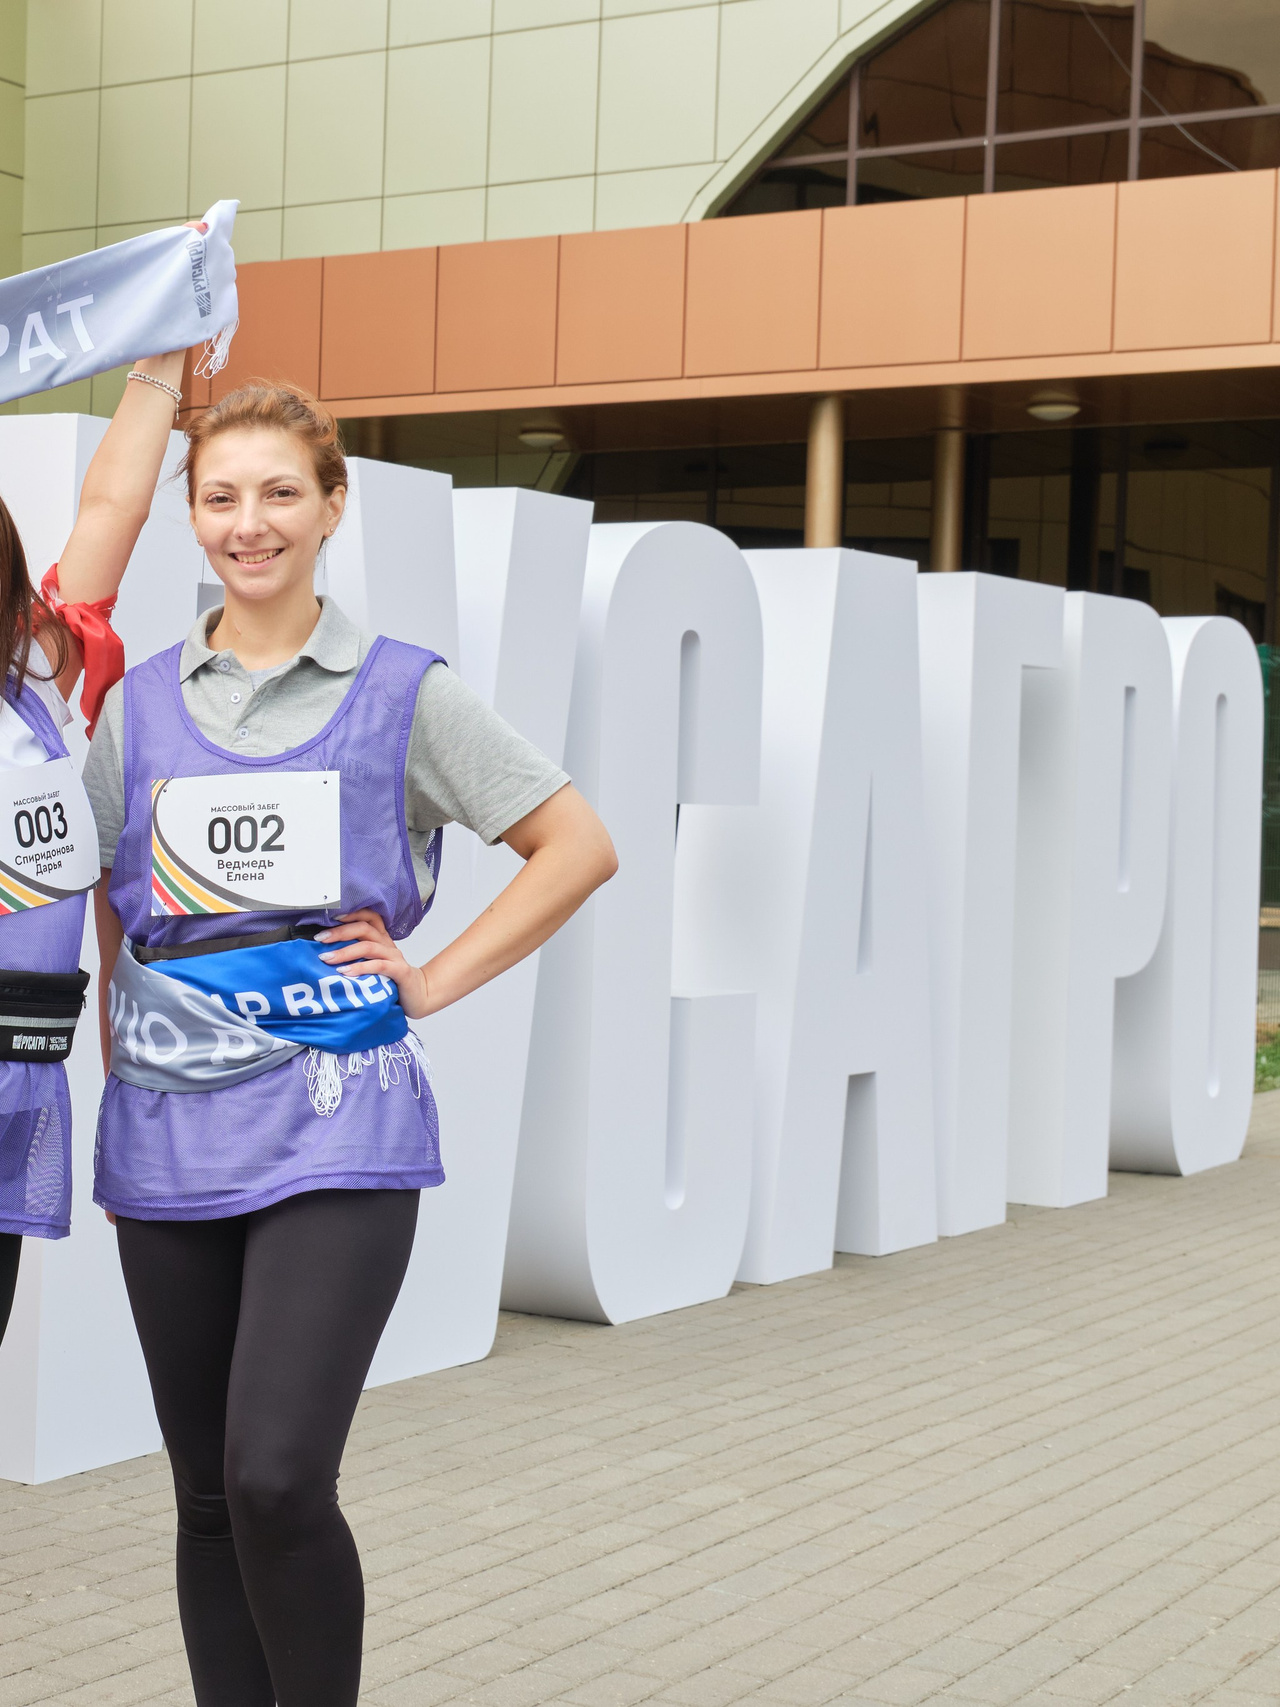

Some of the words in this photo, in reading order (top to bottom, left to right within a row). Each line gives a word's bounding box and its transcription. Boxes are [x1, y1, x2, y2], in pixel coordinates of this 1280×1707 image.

[186, 240, 207, 293] РУСАГРО
[13, 793, 47, 807] МАССОВЫЙ
[47, 790, 60, 801] ЗАБЕГ
[210, 803, 255, 813] МАССОВЫЙ
[257, 803, 280, 811] ЗАБЕГ
[14, 801, 68, 848] 003
[208, 814, 285, 855] 002
[14, 843, 75, 866] Спиридонова
[35, 860, 63, 876] Дарья
[217, 859, 274, 870] Ведмедь
[226, 872, 265, 881] Елена
[108, 979, 187, 1065] ЦО
[20, 1035, 46, 1050] РУСАГРО
